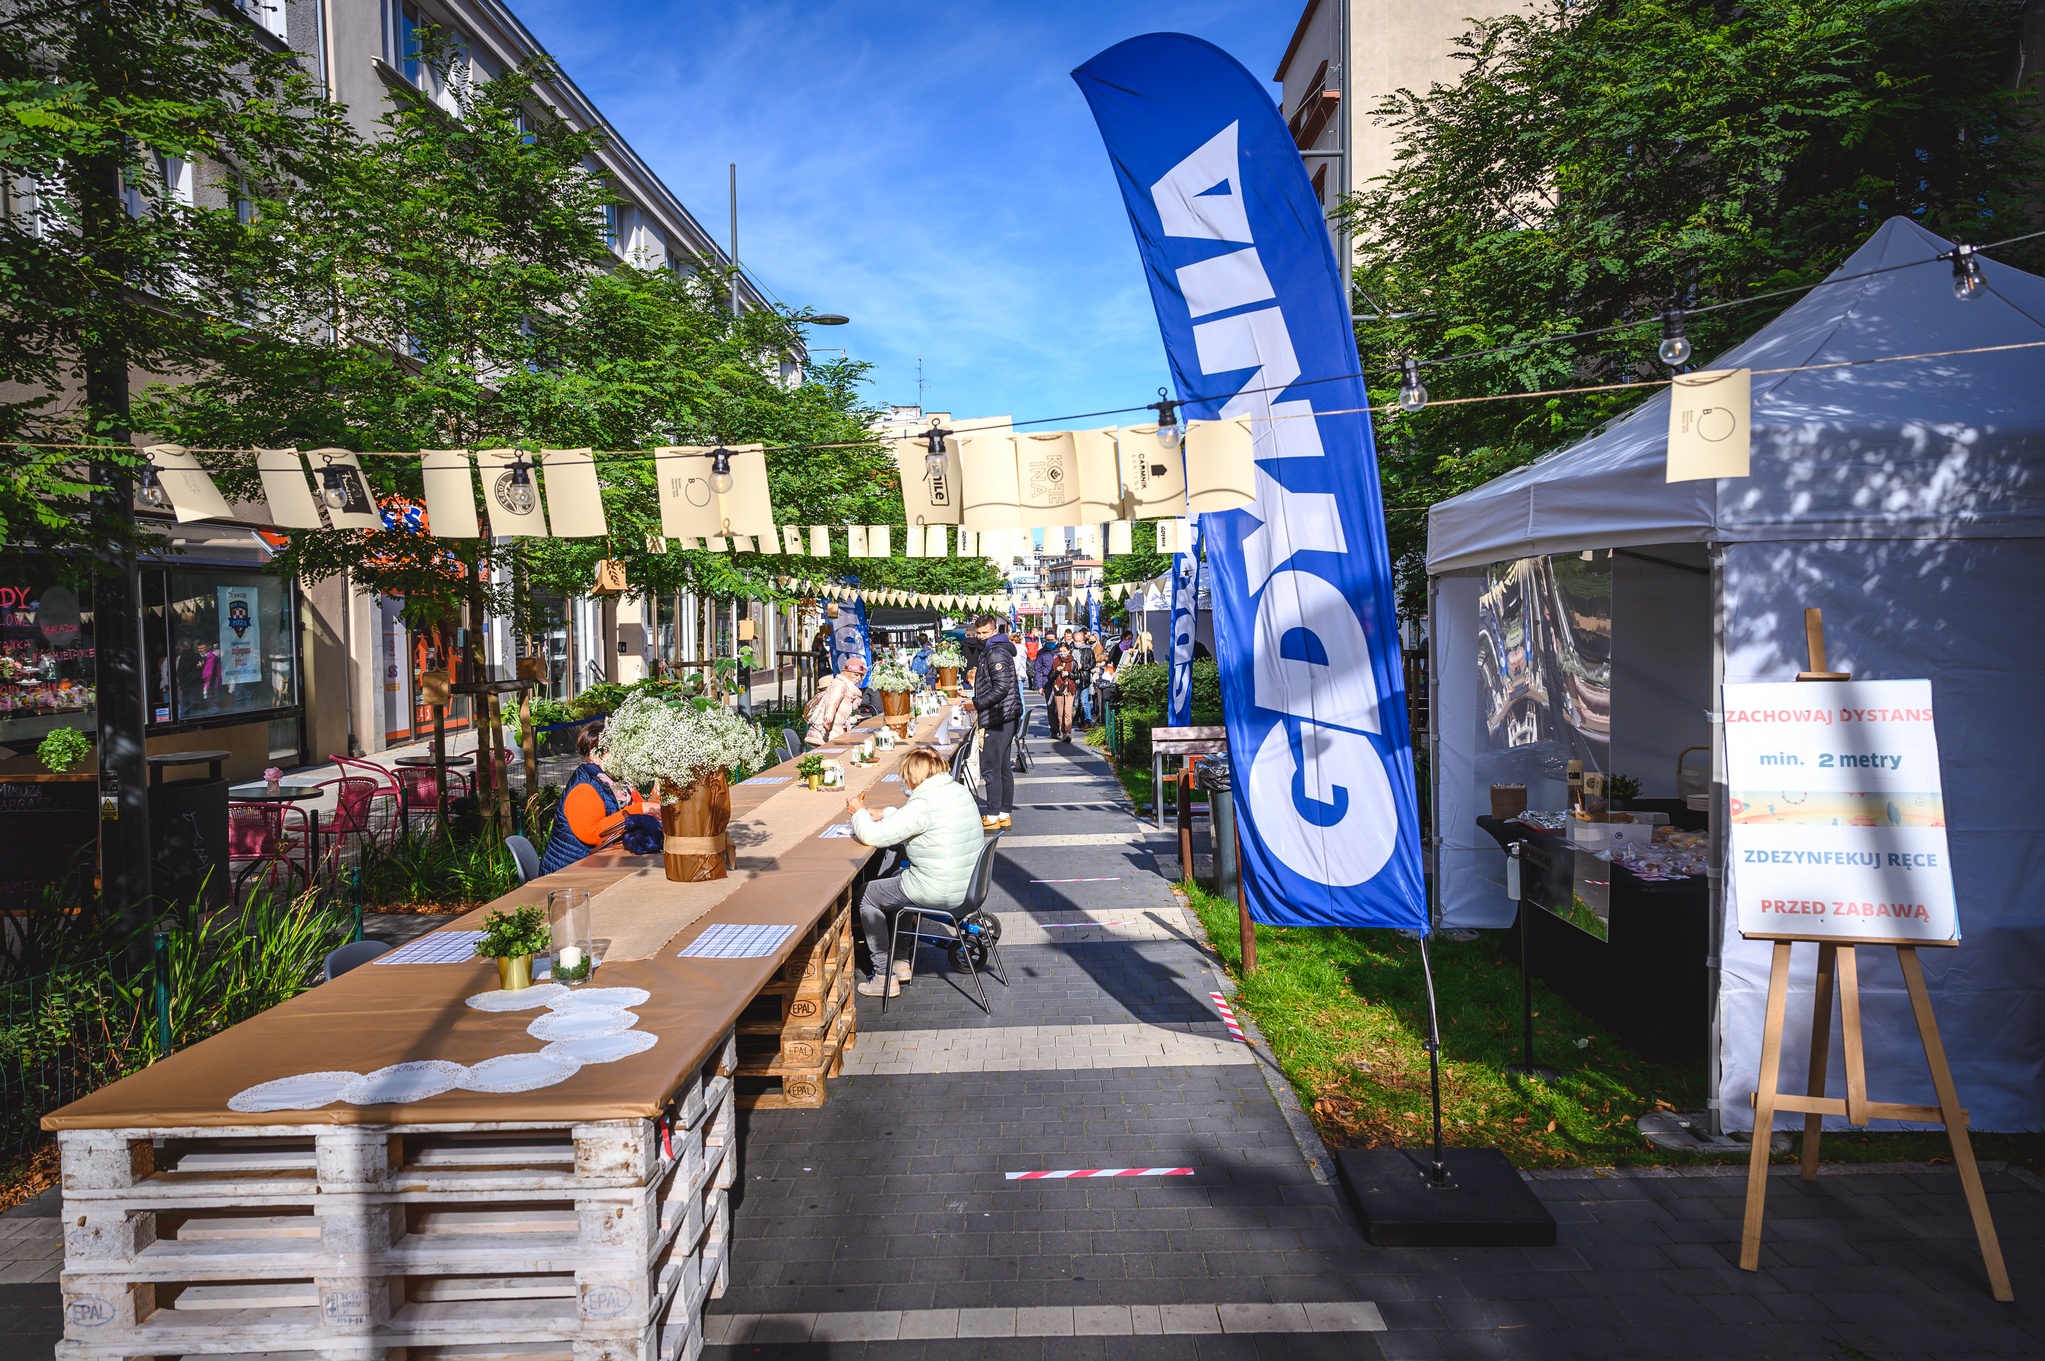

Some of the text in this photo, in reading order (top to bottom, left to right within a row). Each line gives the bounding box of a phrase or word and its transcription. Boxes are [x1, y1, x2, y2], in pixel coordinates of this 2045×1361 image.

[1138, 453, 1148, 489] CARMNIK
[1152, 120, 1400, 887] GDYNIA
[1726, 708, 1934, 726] ZACHOWAJ DYSTANS
[1760, 752, 1902, 770] min. 2 metry
[1744, 850, 1938, 870] ZDEZYNFEKUJ RĘCE
[1761, 899, 1930, 923] PRZED ZABAWĄ
[790, 965, 811, 975] EPAL
[792, 1004, 811, 1014] EPAL
[789, 1047, 809, 1056] EPAL
[793, 1085, 812, 1095] EPAL
[589, 1294, 624, 1310] EPAL
[73, 1304, 108, 1321] EPAL
